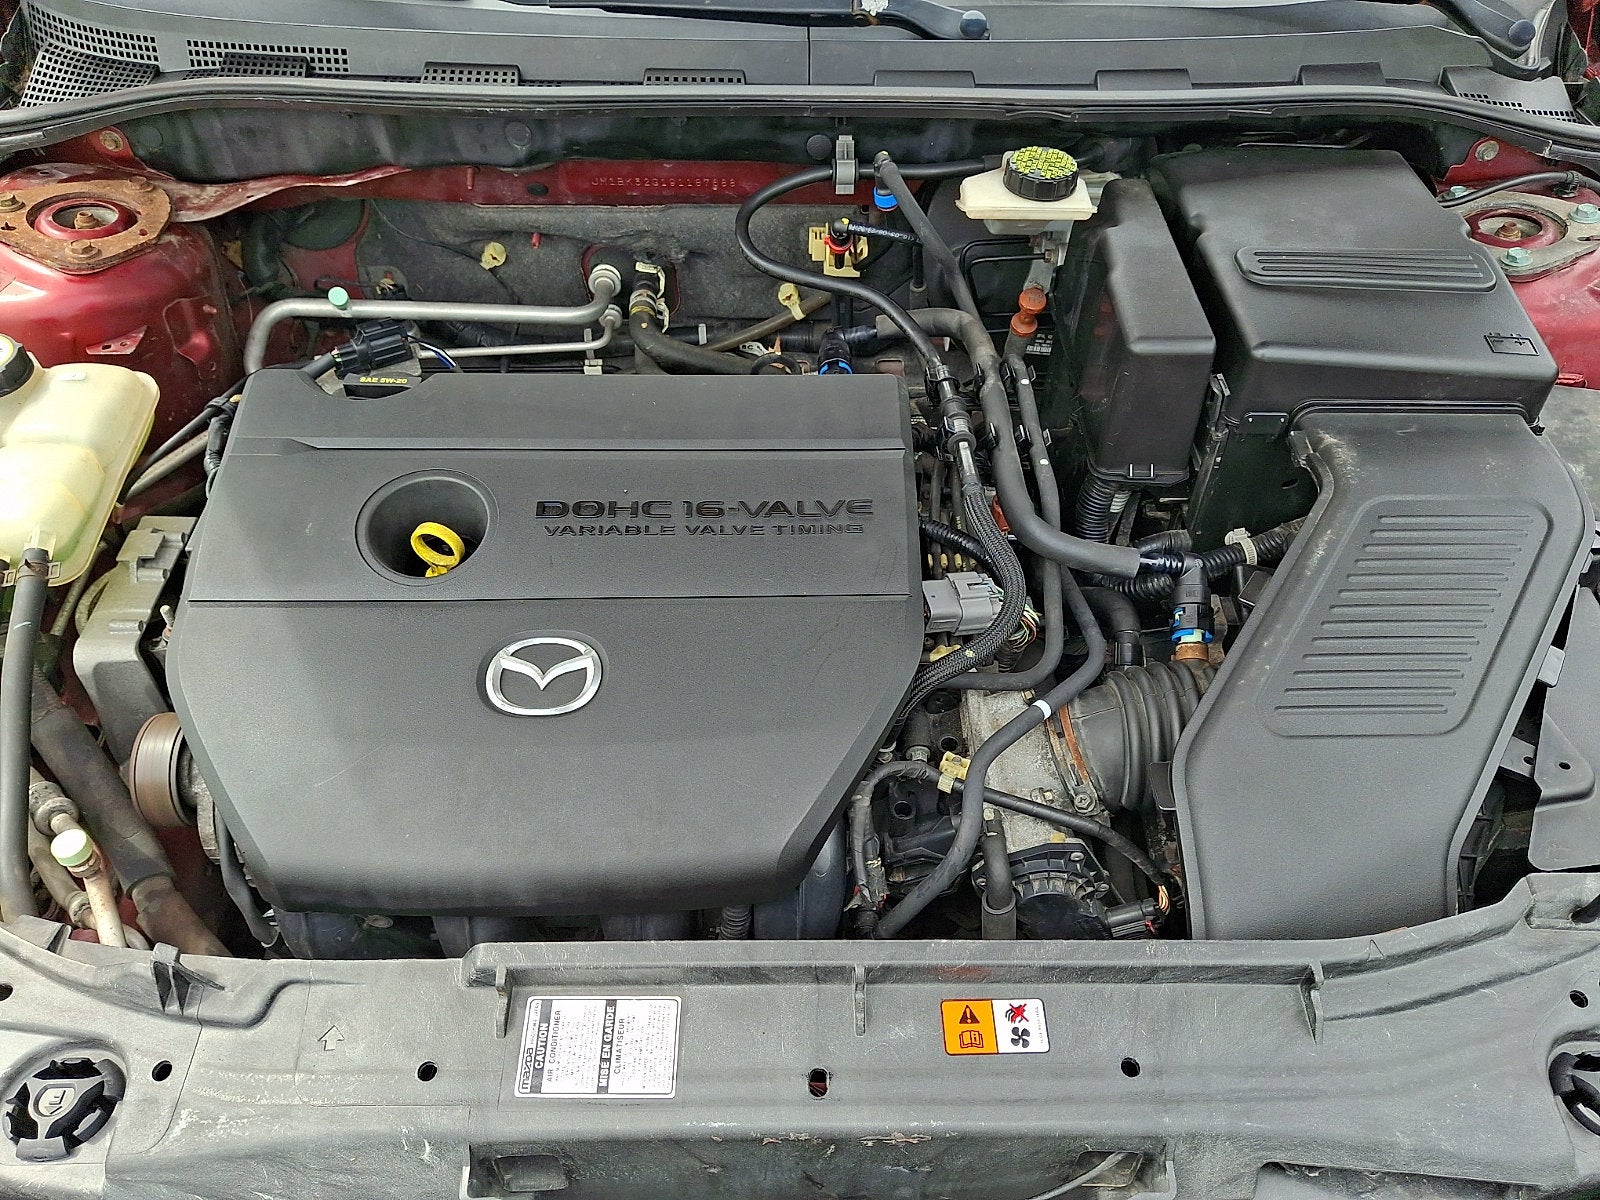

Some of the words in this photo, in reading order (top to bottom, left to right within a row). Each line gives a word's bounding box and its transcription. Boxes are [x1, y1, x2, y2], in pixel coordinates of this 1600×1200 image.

[534, 500, 673, 519] DOHC
[682, 498, 875, 519] 16-VALVE
[543, 524, 677, 537] VARIABLE
[684, 524, 766, 537] VALVE
[771, 522, 865, 536] TIMING
[549, 1010, 561, 1064] CONDITIONER
[603, 1005, 616, 1043] GARDE
[535, 1023, 549, 1069] CAUTION
[601, 1044, 612, 1061] EN
[613, 1018, 625, 1075] CLIMATISEUR
[546, 1069, 555, 1082] AIR
[598, 1060, 610, 1087] MISE
